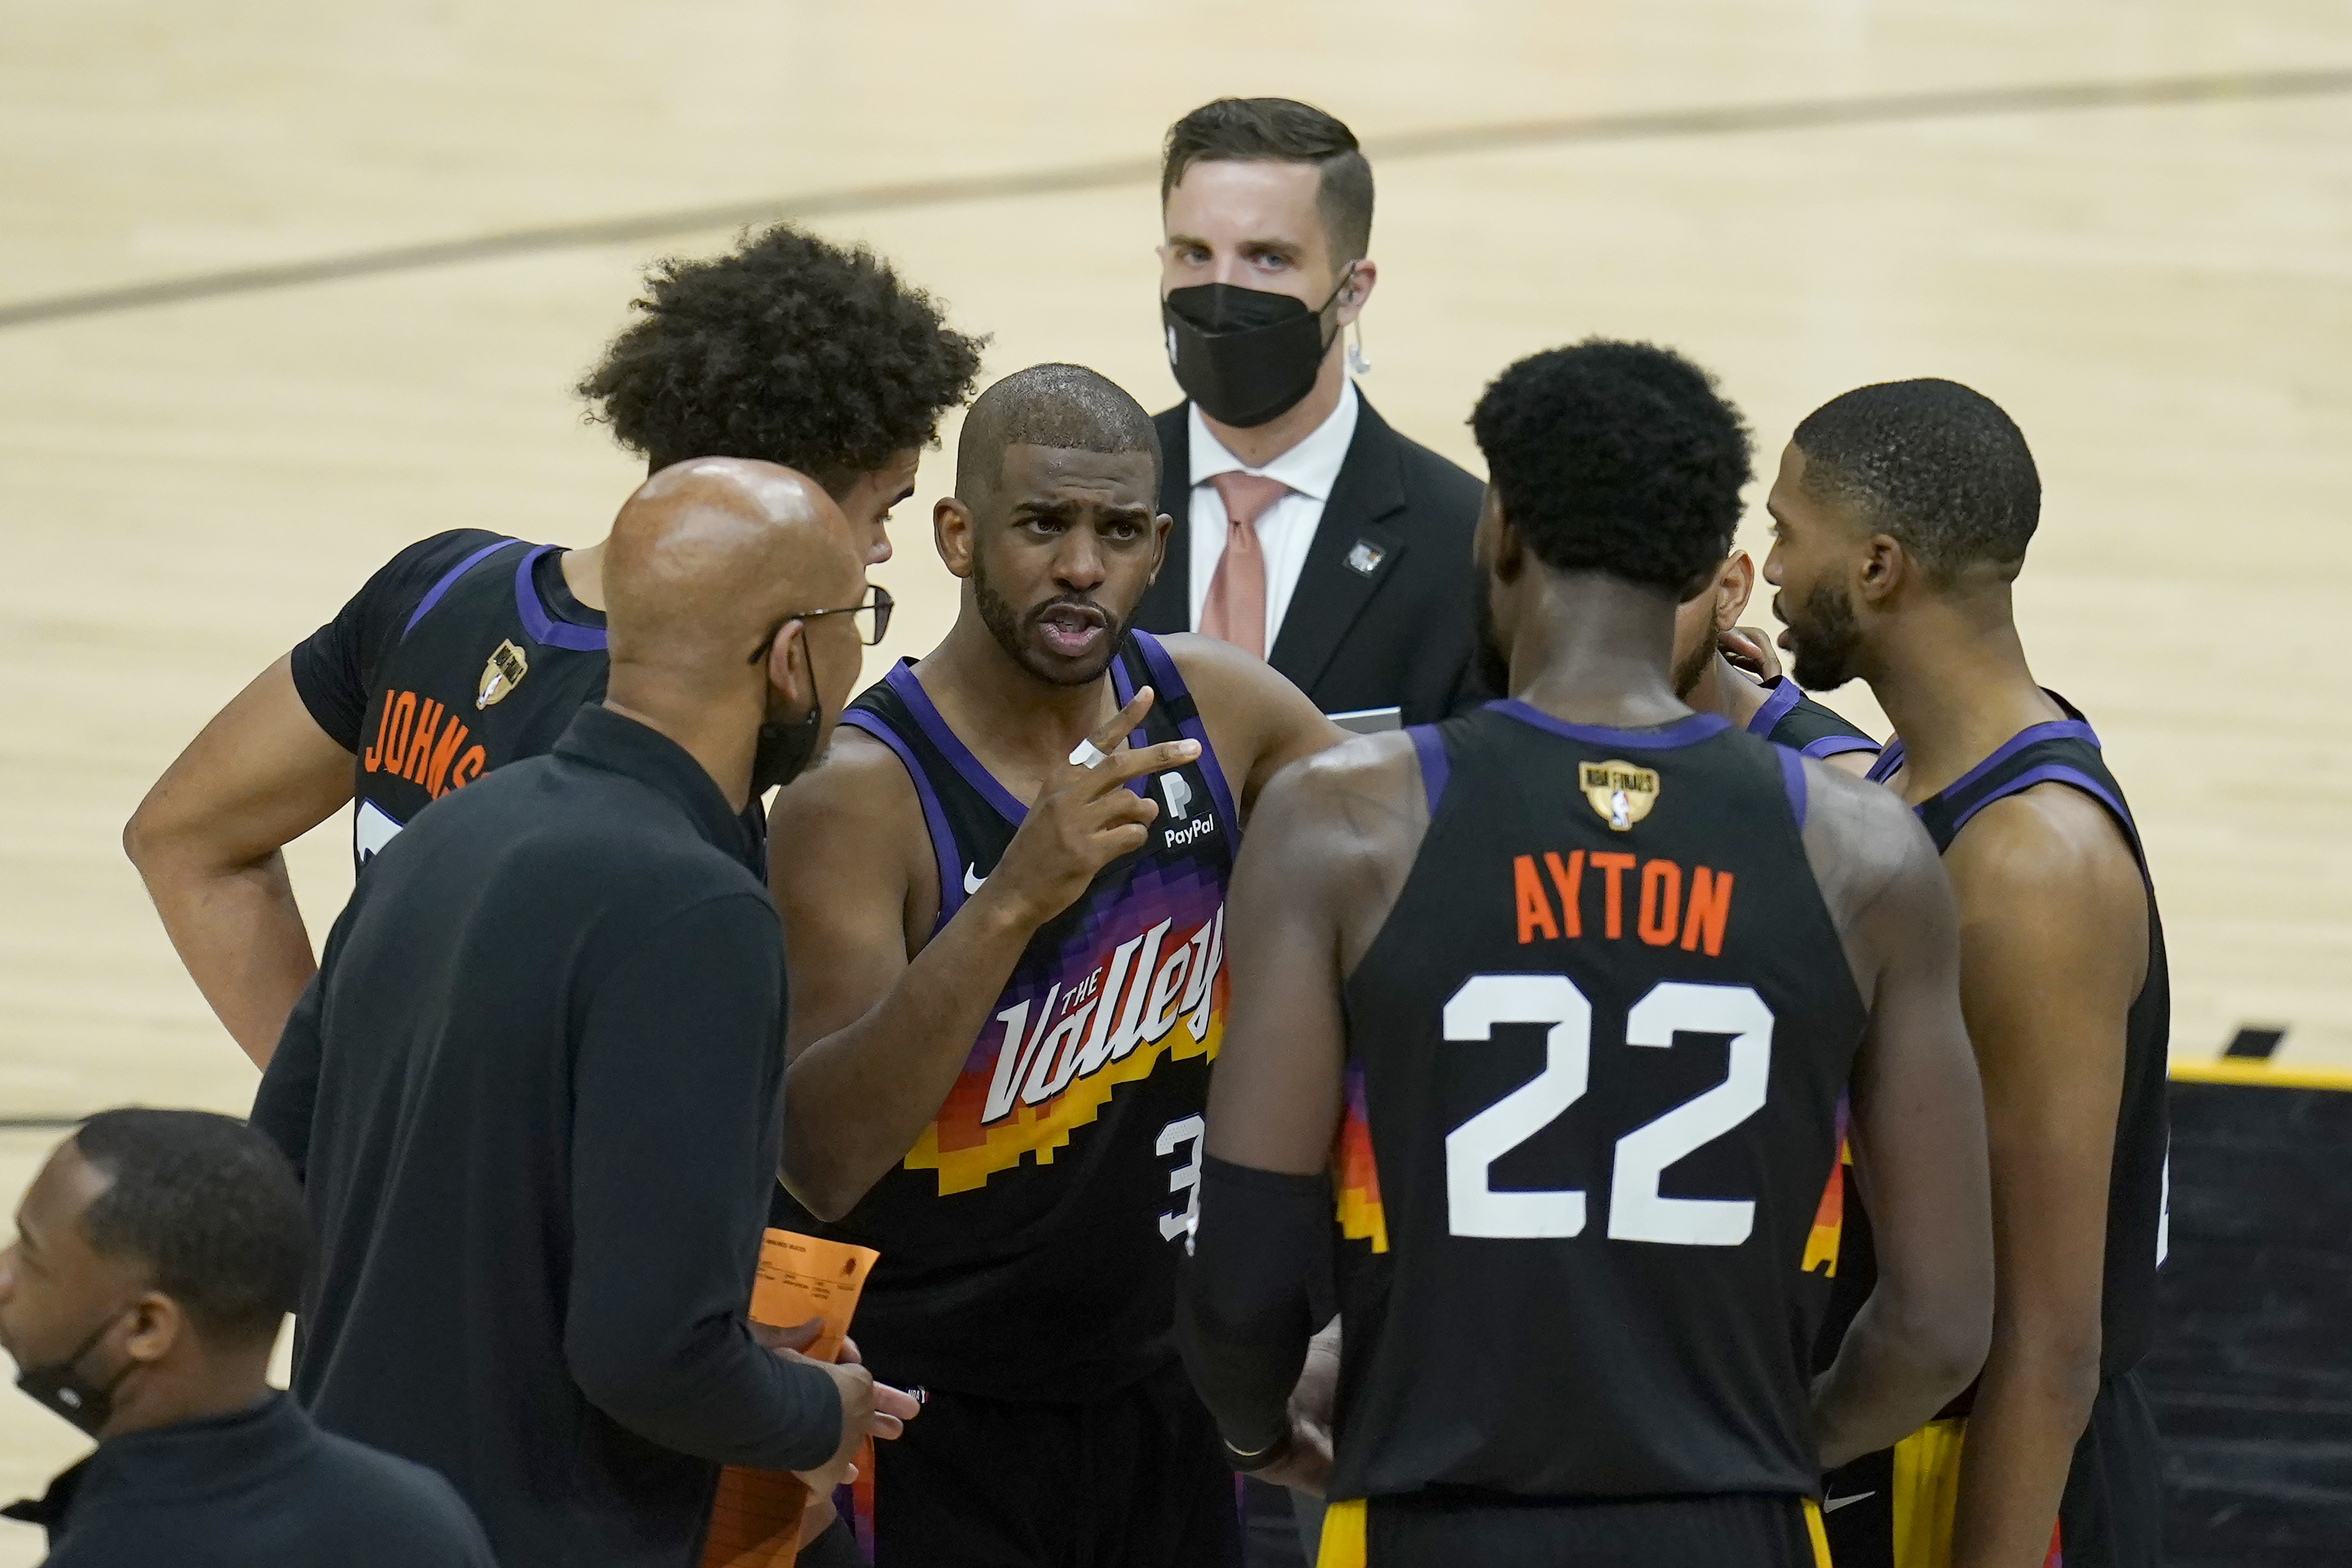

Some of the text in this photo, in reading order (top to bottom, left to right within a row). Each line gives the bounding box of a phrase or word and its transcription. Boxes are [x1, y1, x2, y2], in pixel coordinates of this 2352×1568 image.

[365, 689, 490, 800] JOHNS
[1165, 813, 1214, 848] PayPal
[1513, 850, 1734, 957] AYTON
[981, 901, 1224, 1125] Valley
[1061, 966, 1103, 1016] THE
[1443, 975, 1775, 1246] 22
[1155, 1112, 1205, 1242] 3
